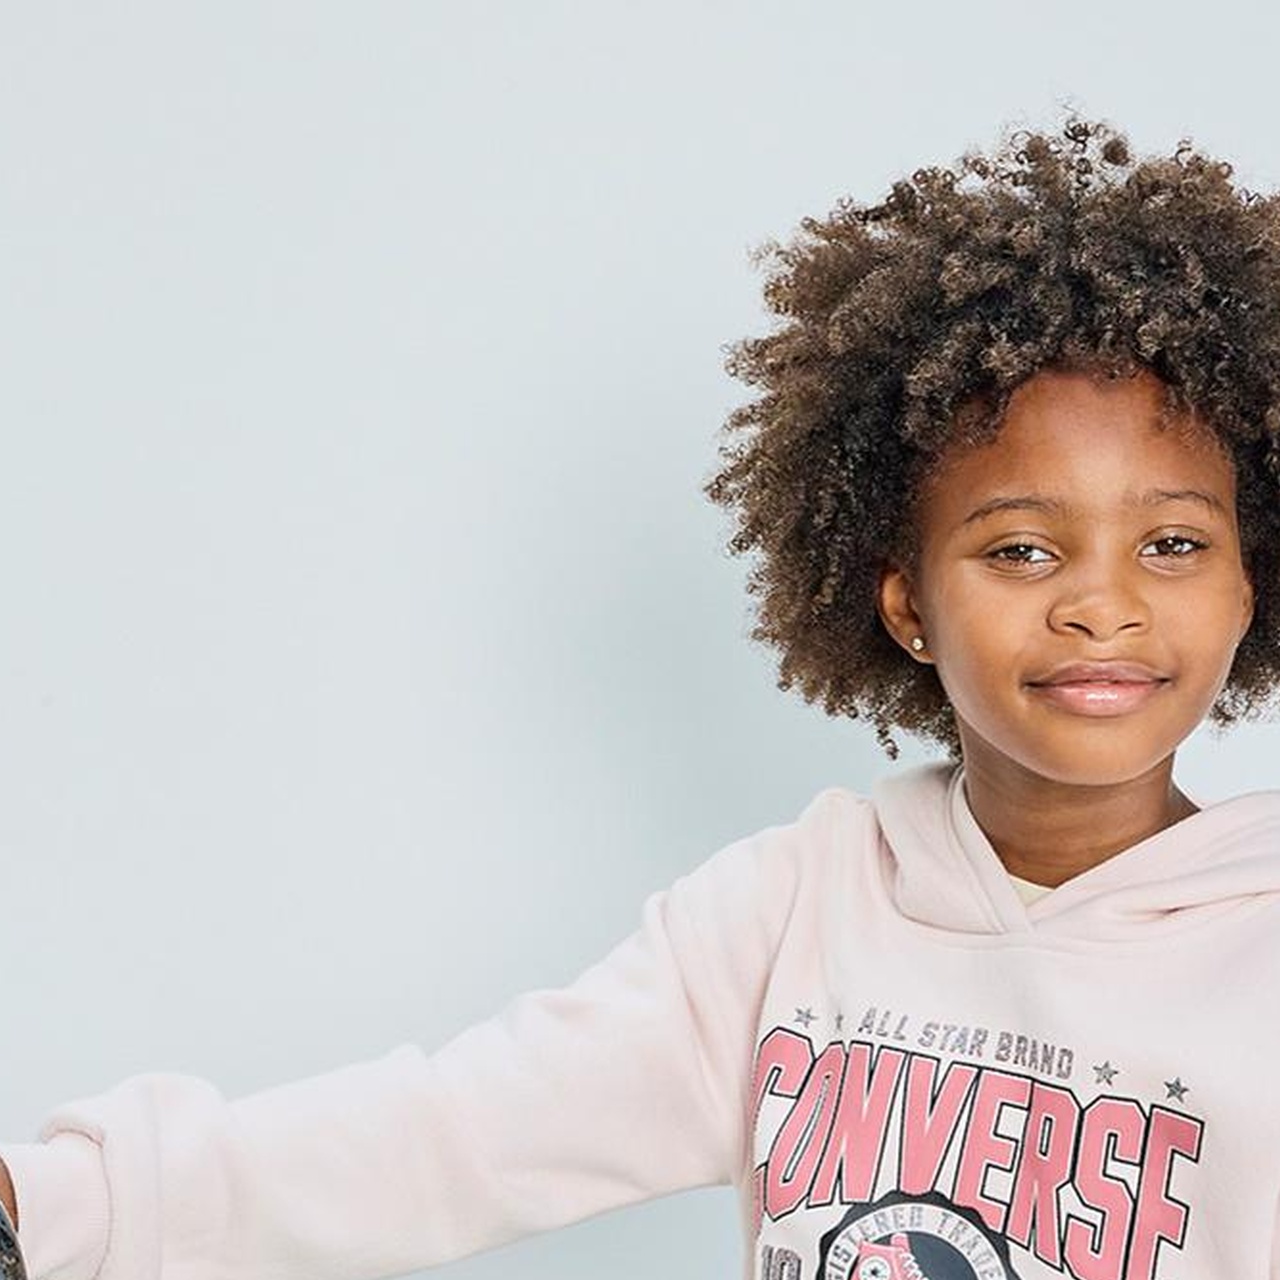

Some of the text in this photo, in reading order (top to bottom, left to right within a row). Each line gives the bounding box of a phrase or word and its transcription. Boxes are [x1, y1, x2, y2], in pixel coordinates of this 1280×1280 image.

[857, 1007, 1074, 1080] ALL STAR BRAND
